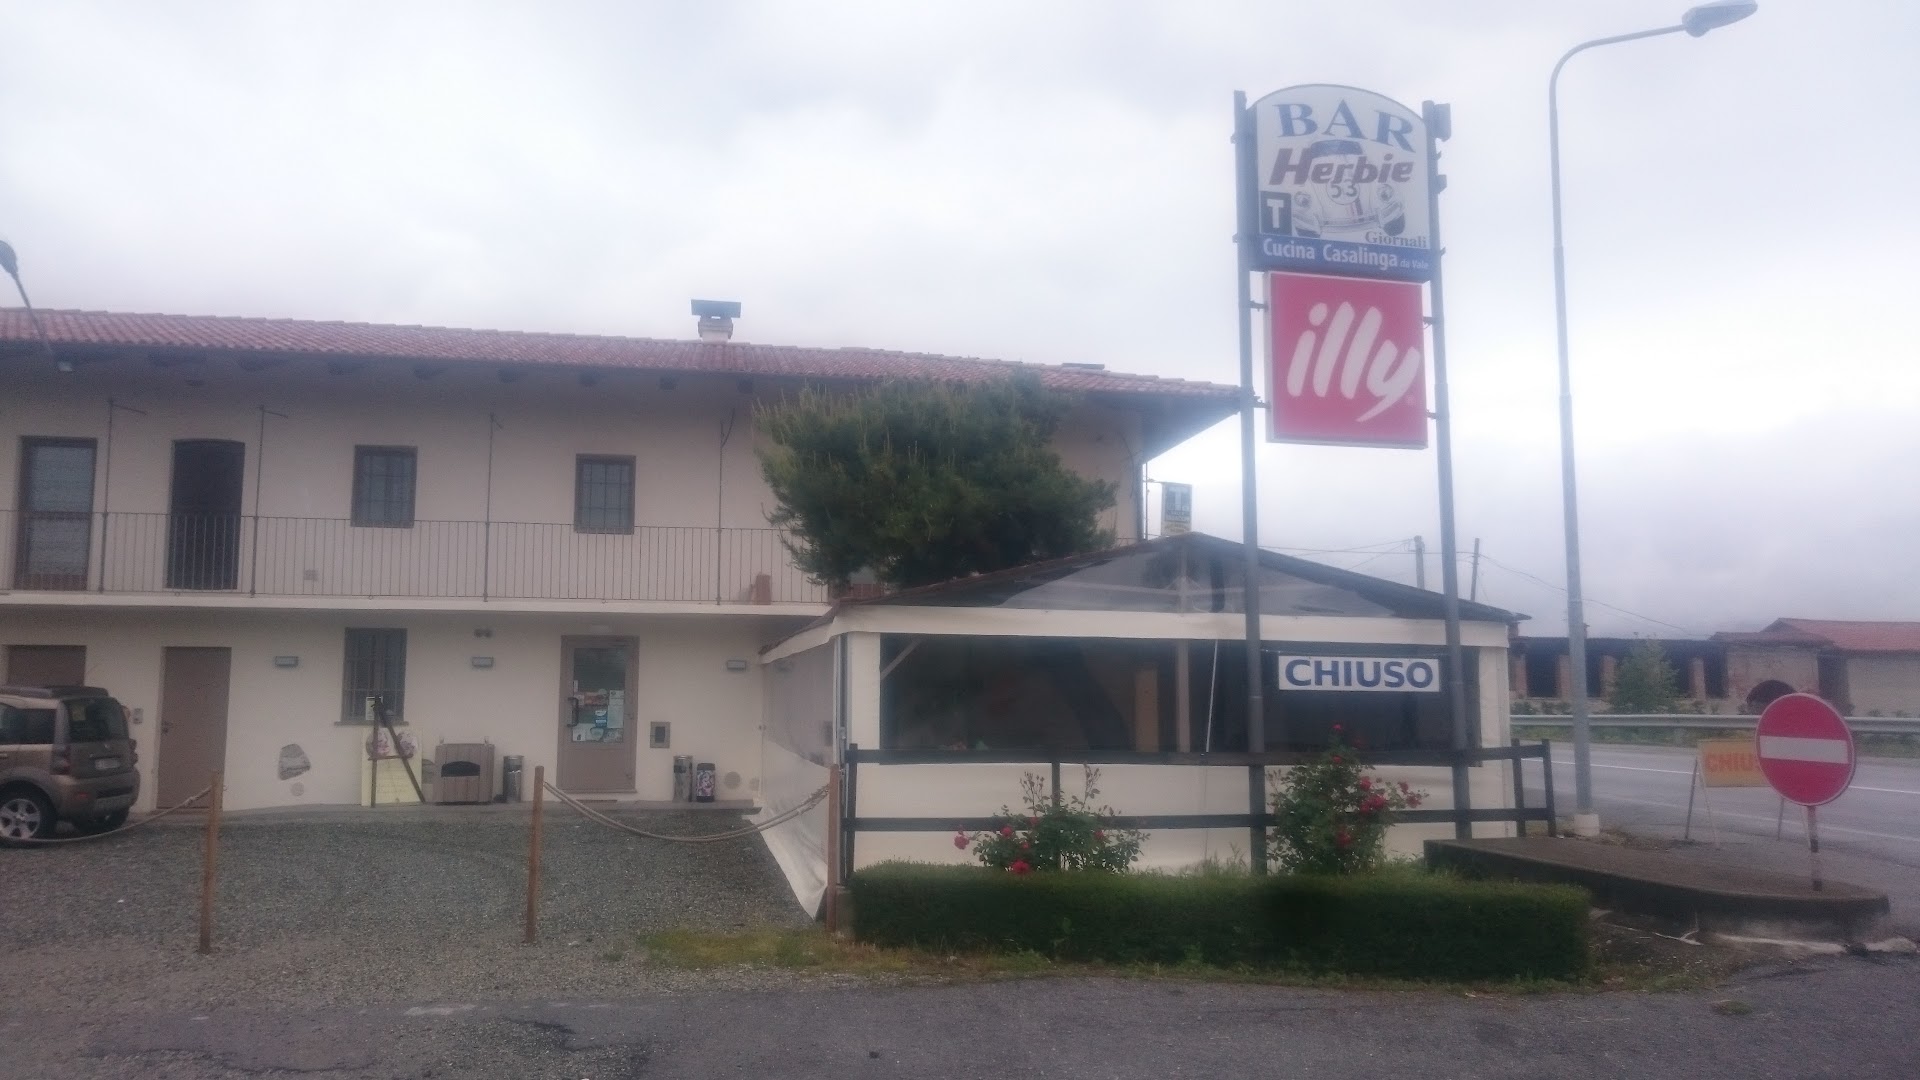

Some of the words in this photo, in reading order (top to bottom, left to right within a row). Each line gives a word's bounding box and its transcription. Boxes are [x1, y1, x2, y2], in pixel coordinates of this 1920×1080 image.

[1272, 98, 1416, 153] BAR
[1269, 148, 1414, 185] Herbie
[1331, 179, 1357, 198] 53
[1266, 198, 1284, 229] T
[1263, 238, 1316, 260] Cucina
[1322, 244, 1398, 271] Casalinga
[1365, 231, 1428, 249] Giornali
[1286, 301, 1421, 423] illy
[1285, 659, 1433, 689] CHIUSO
